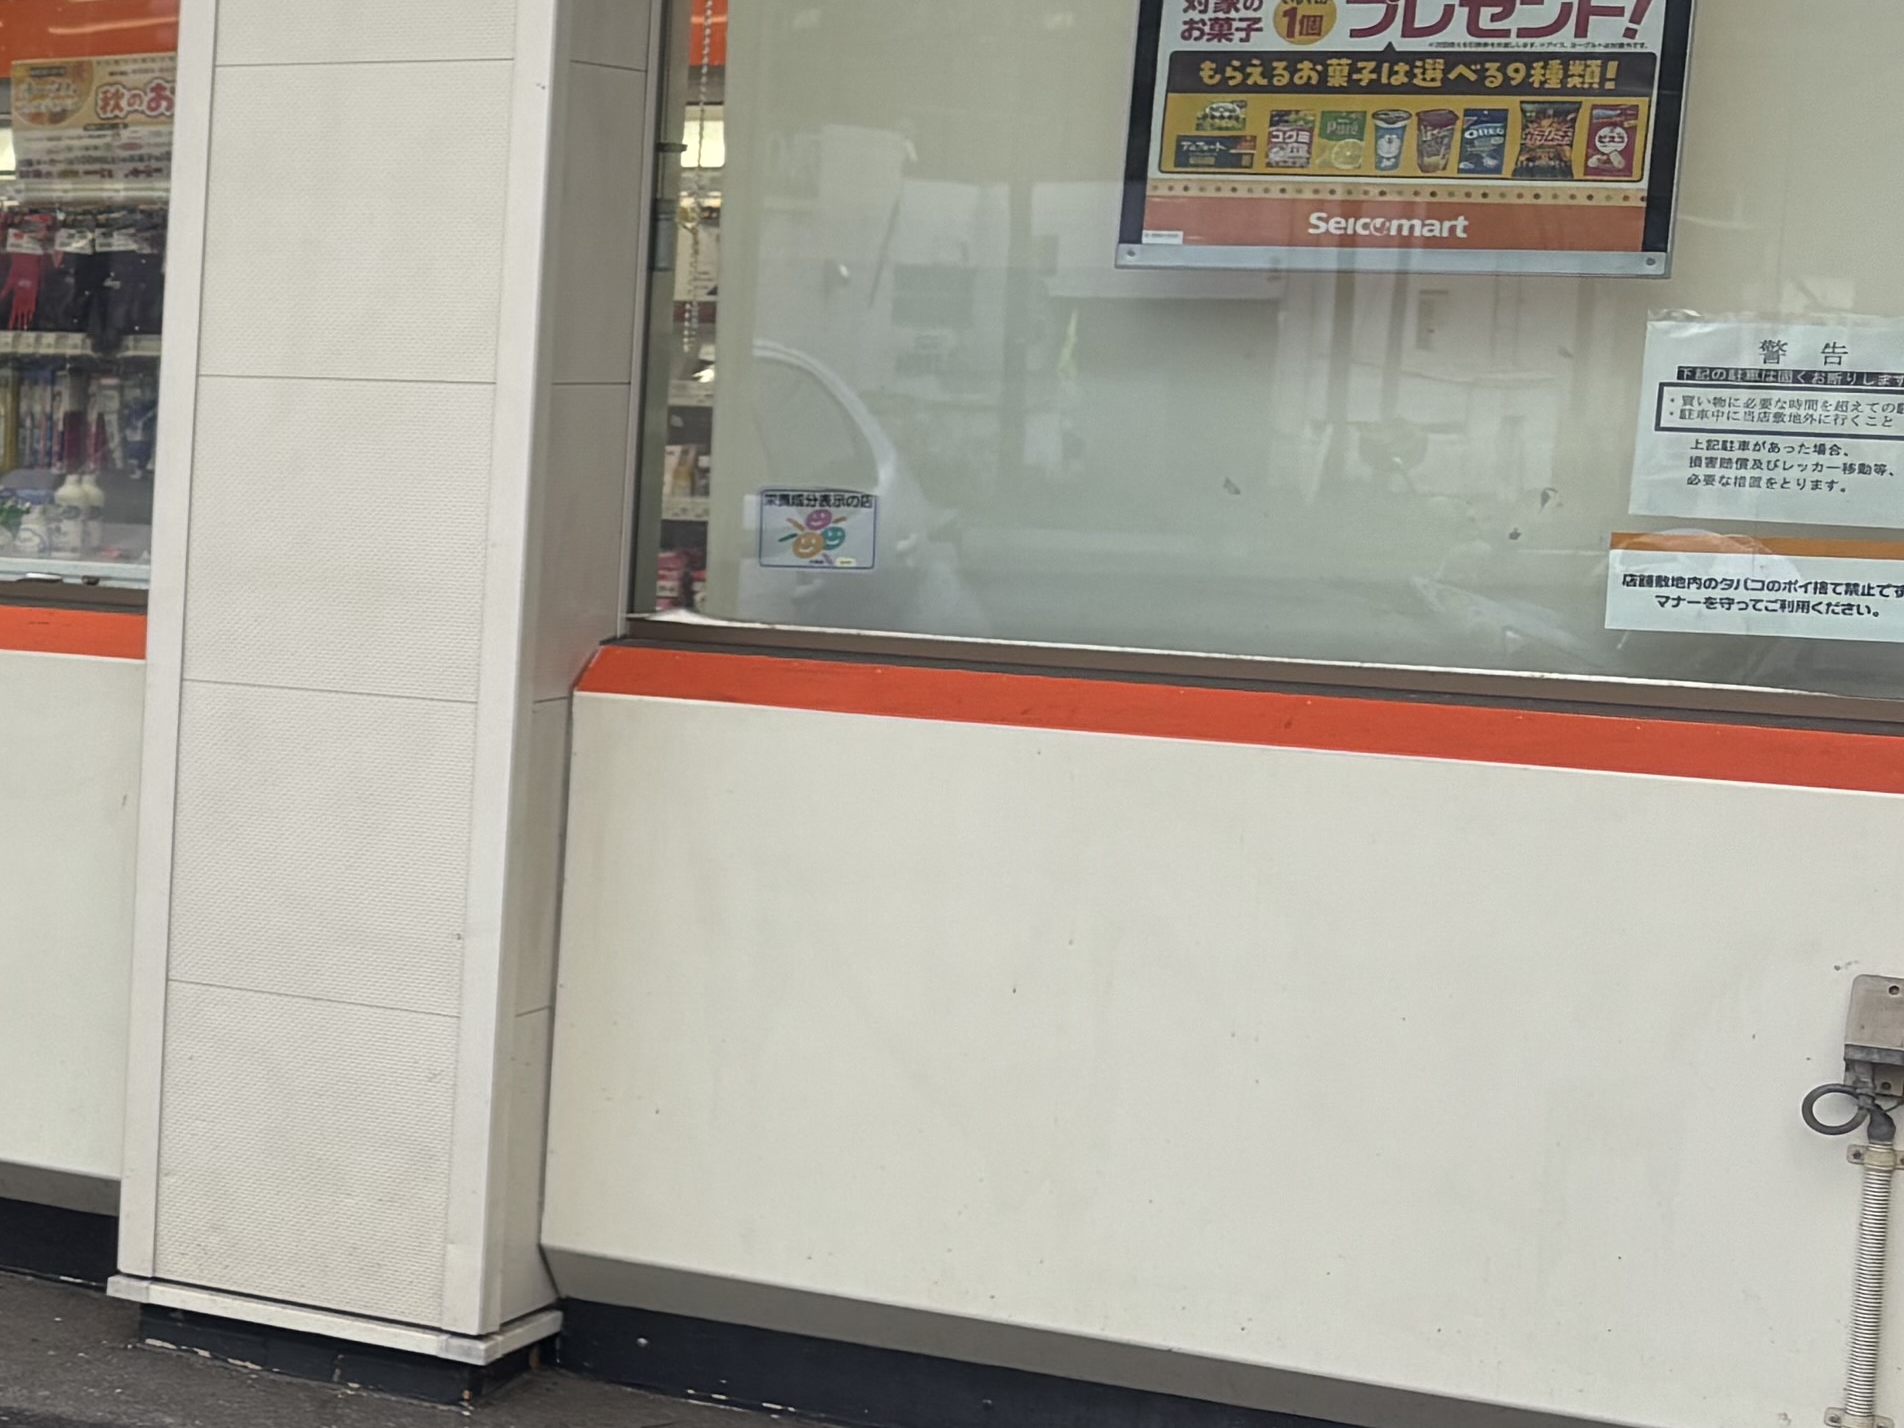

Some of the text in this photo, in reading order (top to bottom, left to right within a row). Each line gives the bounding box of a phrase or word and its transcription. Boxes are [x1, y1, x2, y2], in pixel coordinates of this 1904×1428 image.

[1180, 18, 1264, 44] お菓子
[1308, 212, 1469, 240] Seicomart
[1690, 439, 1849, 457] 上記駐車があった場合、
[1689, 455, 1895, 477] 損害賠償及びレッカー移動等、
[1686, 474, 1847, 493] 必要な措置をとります。
[1654, 594, 1880, 618] マナーを守ってご利用ください。
